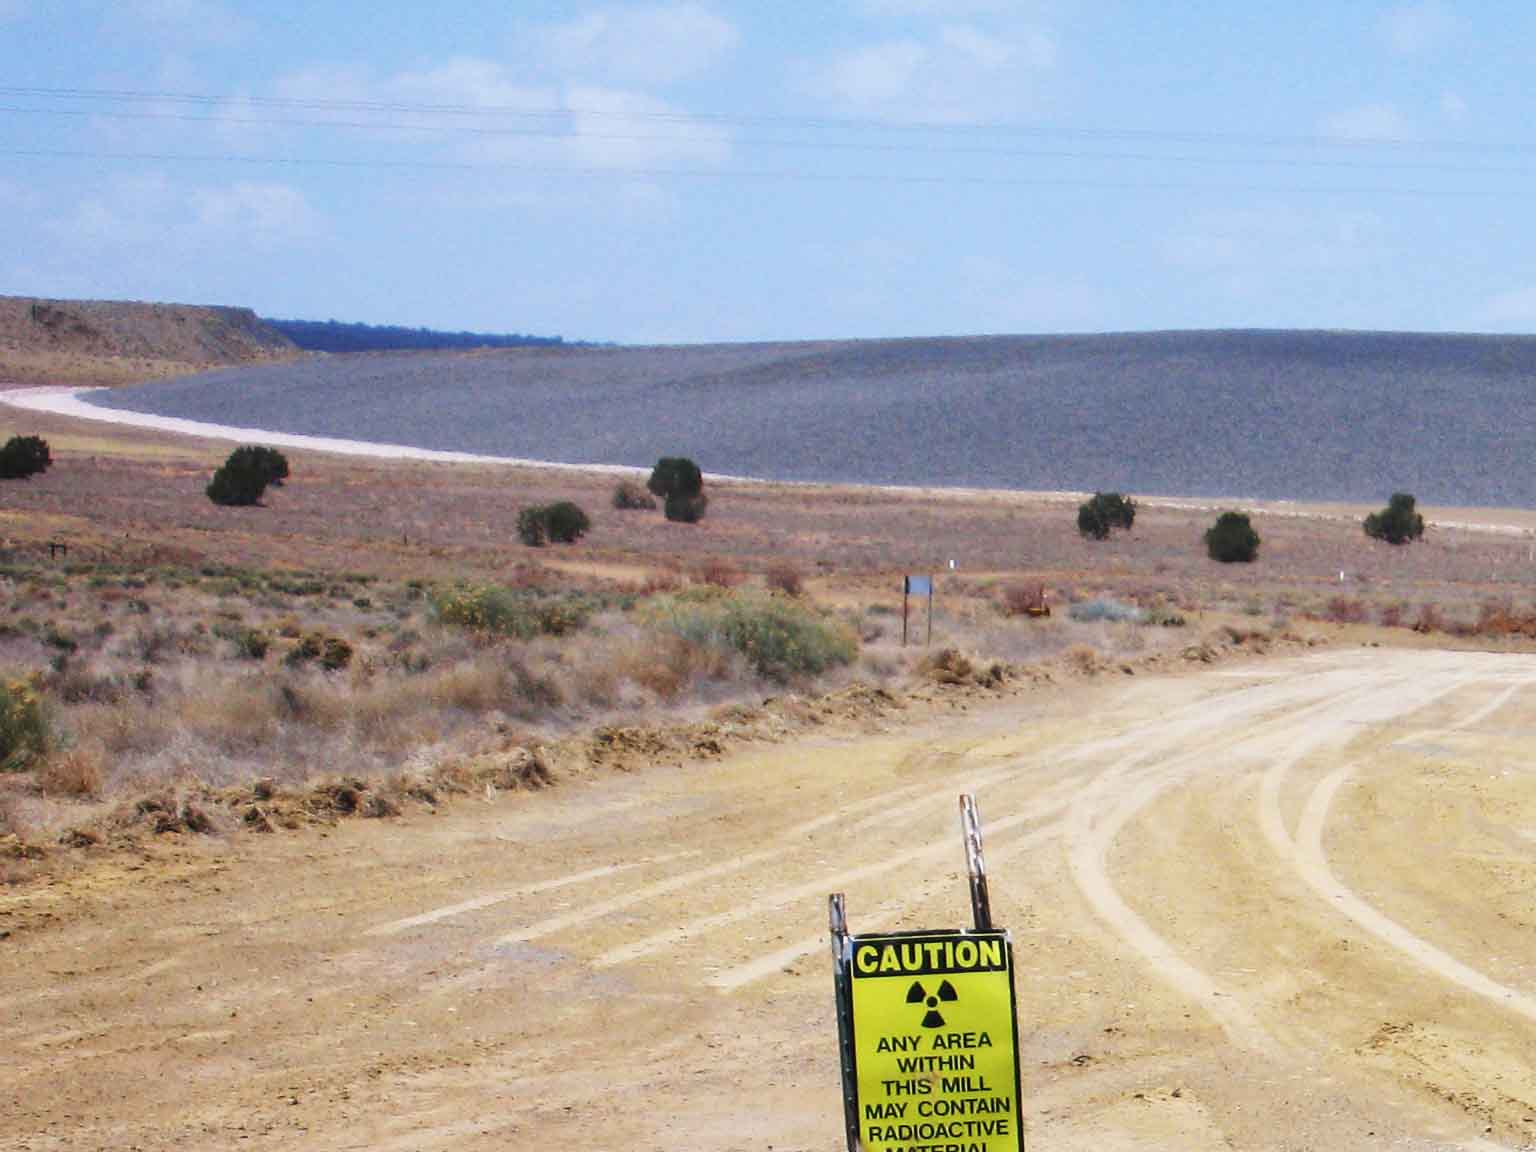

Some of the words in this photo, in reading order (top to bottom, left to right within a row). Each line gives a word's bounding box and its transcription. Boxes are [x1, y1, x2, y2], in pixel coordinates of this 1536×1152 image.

[856, 940, 1002, 973] CAUTION
[876, 1034, 922, 1053] ANY
[932, 1032, 993, 1050] AREA
[896, 1054, 975, 1073] WITHIN
[881, 1078, 932, 1096] THIS
[942, 1076, 992, 1094] MILL
[865, 1102, 908, 1120] MAY
[918, 1097, 1010, 1117] CONTAIN
[868, 1120, 1009, 1142] RADIOACTIVE
